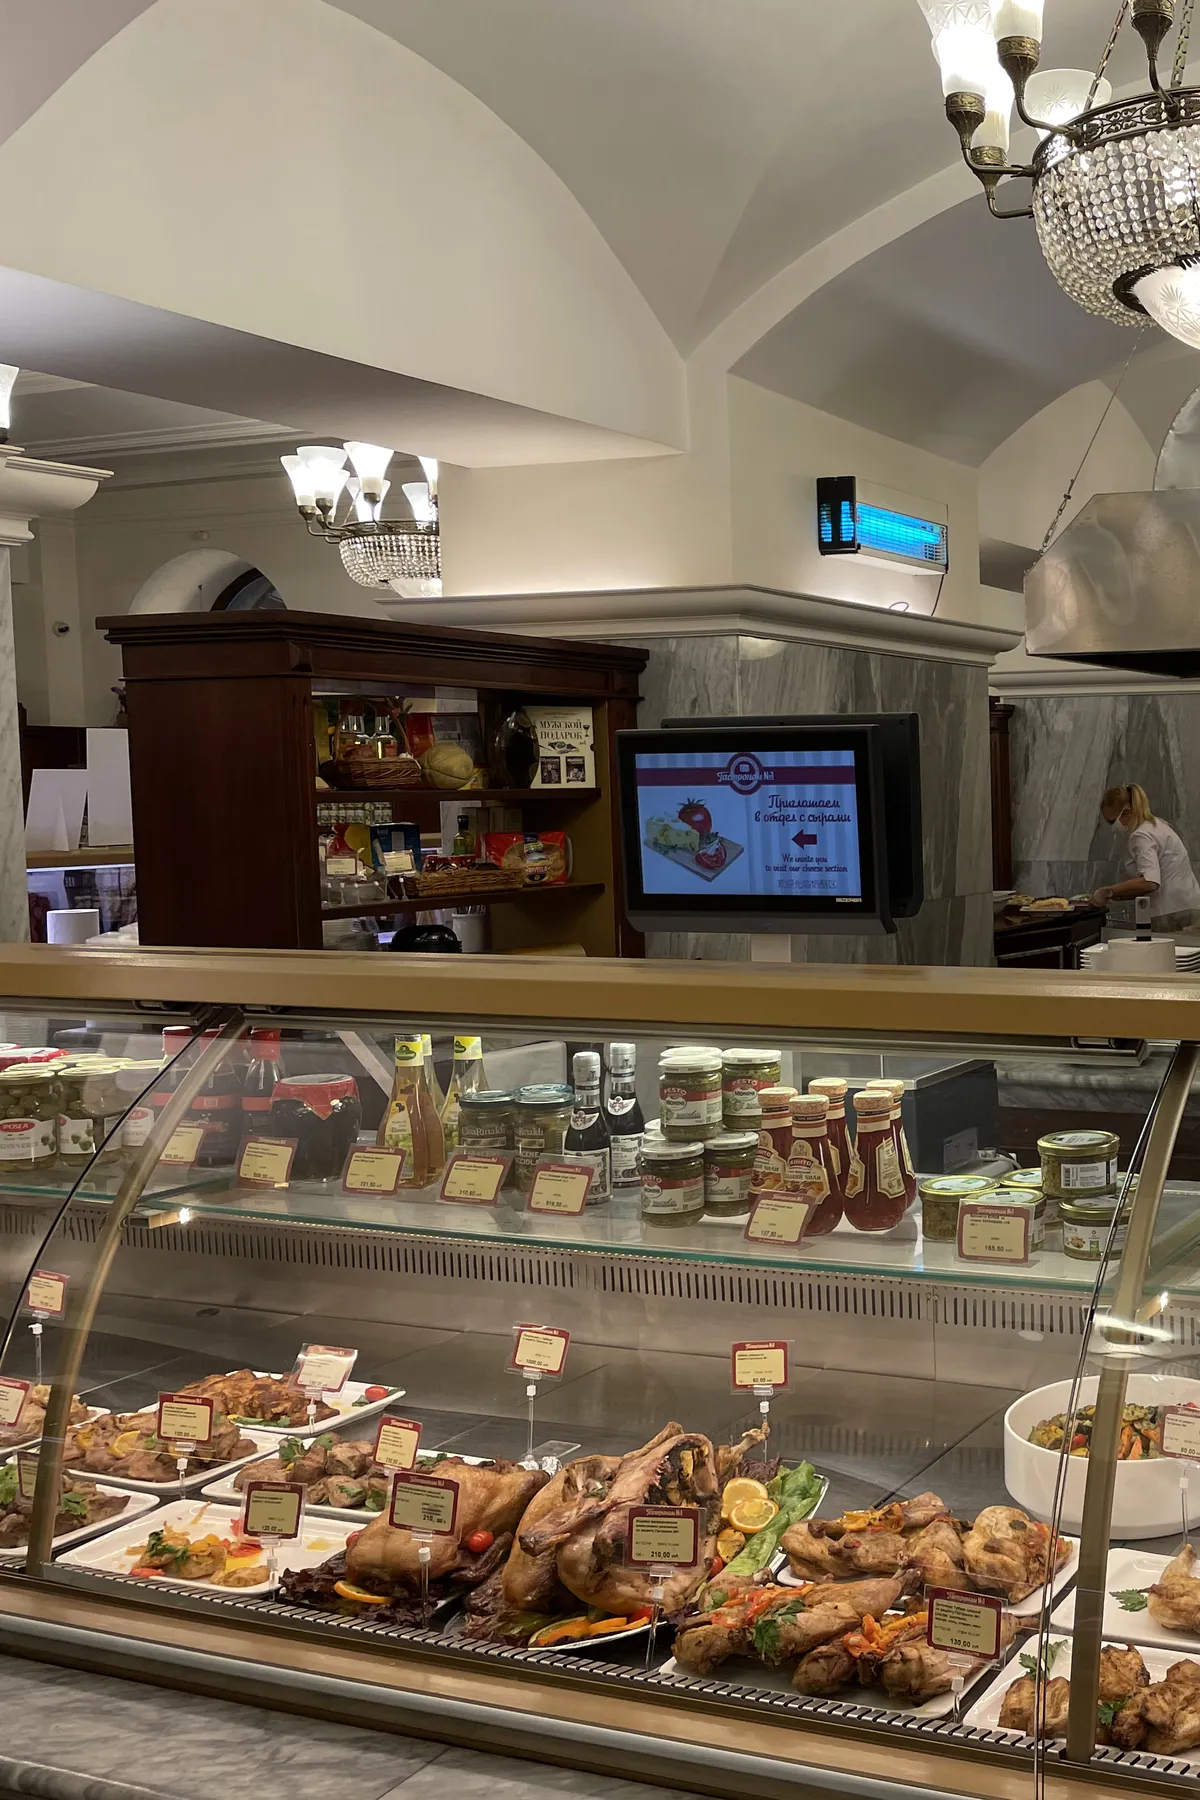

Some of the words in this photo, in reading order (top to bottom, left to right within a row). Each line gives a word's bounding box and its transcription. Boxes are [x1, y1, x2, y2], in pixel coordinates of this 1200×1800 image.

[540, 719, 582, 729] МУЖСКОЙ
[540, 731, 582, 740] ПОДАРОК
[768, 794, 841, 809] Приглашаем
[754, 812, 761, 823] в
[763, 812, 797, 823] отдел
[800, 813, 806, 822] с
[807, 813, 852, 826] сырами
[782, 853, 793, 863] We
[815, 857, 828, 865] you
[765, 864, 772, 872] to
[773, 864, 787, 872] visit
[802, 864, 823, 872] cheese
[664, 1087, 687, 1096] PESTO
